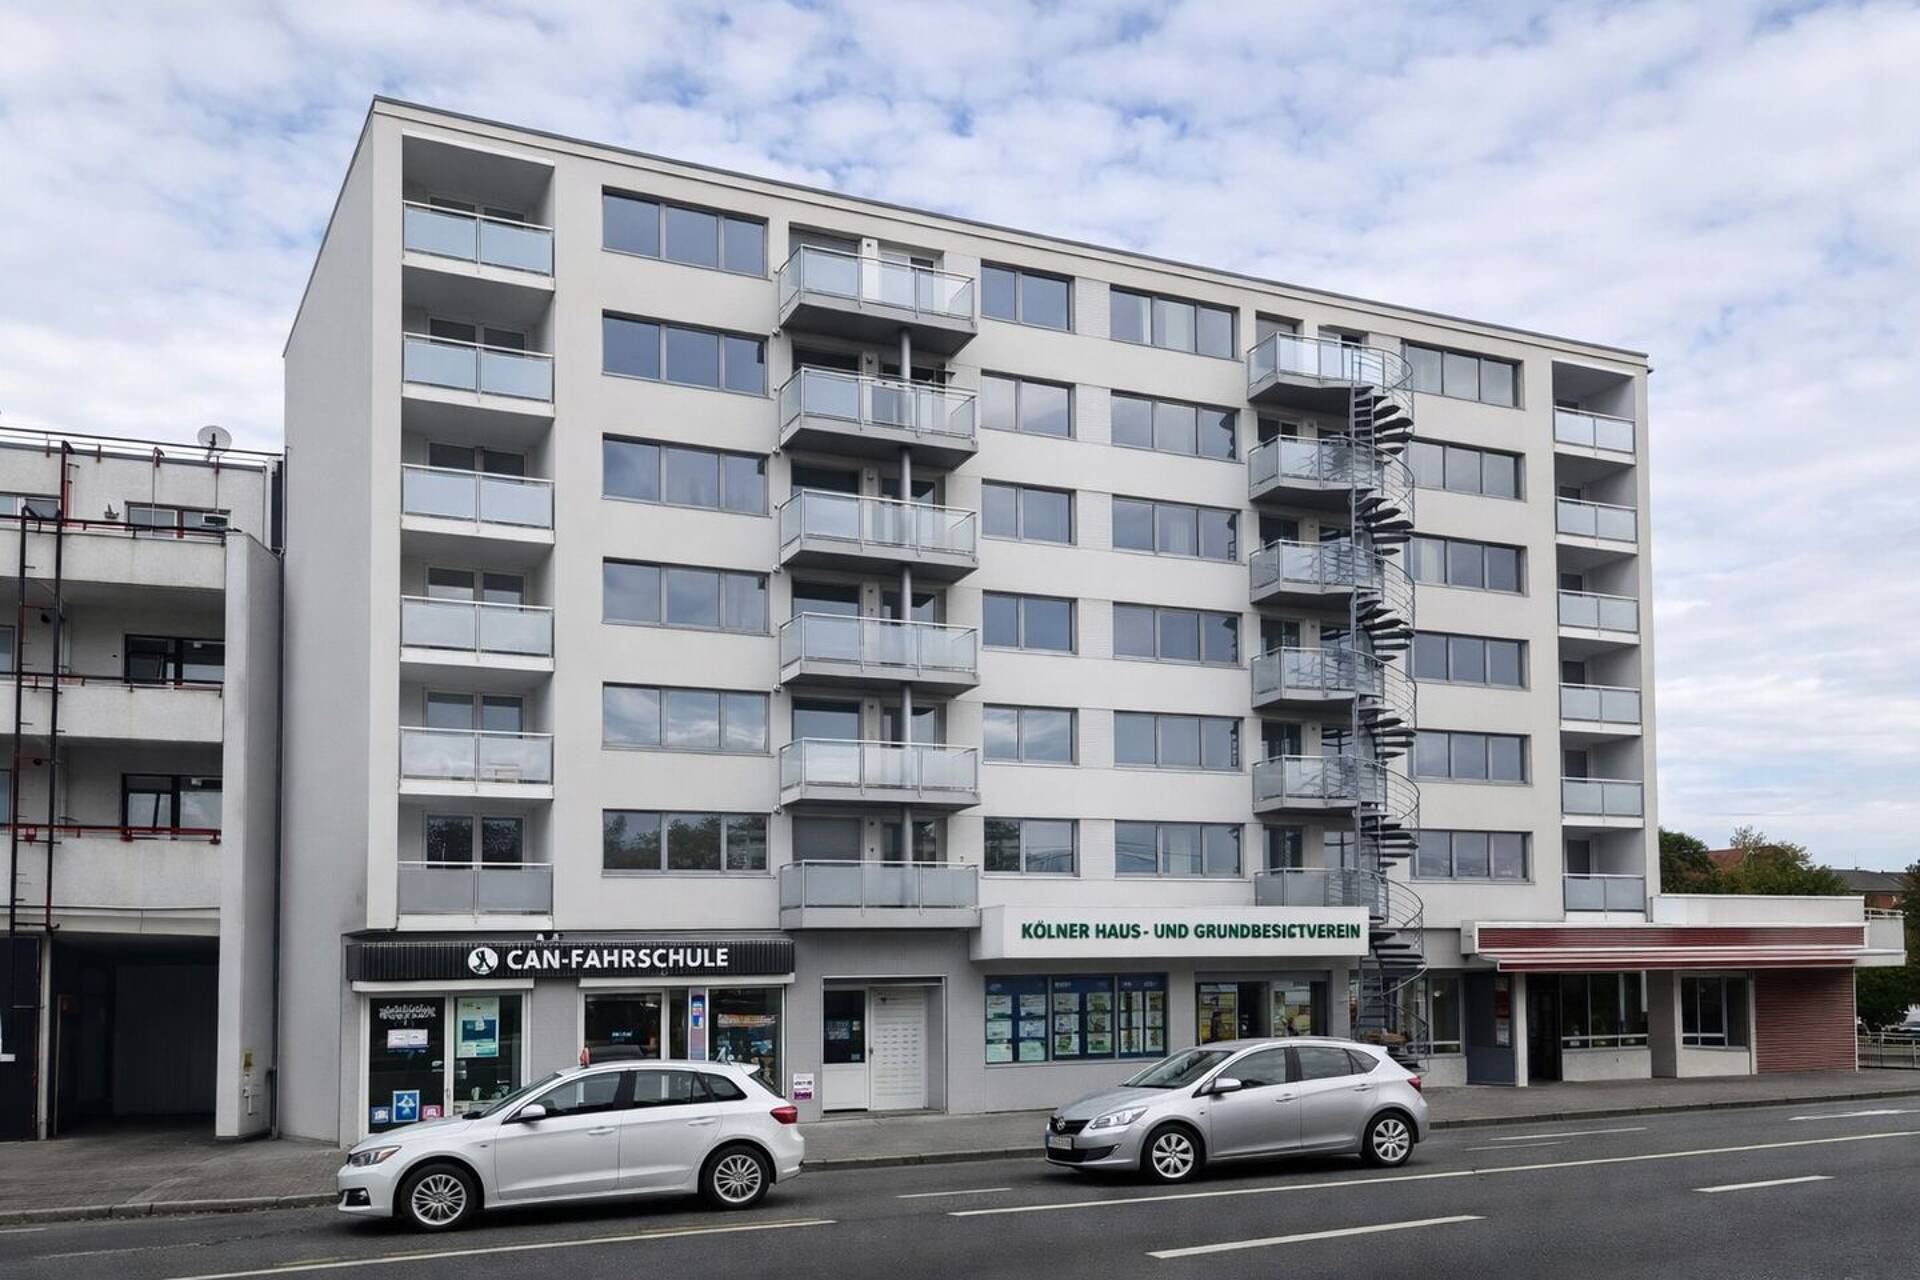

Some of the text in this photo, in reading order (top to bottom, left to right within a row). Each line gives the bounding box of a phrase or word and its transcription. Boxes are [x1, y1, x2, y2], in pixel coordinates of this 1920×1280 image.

[1021, 919, 1090, 939] KÖLNER
[1154, 923, 1189, 939] UND
[506, 947, 729, 970] CAN-FAHRSCHULE
